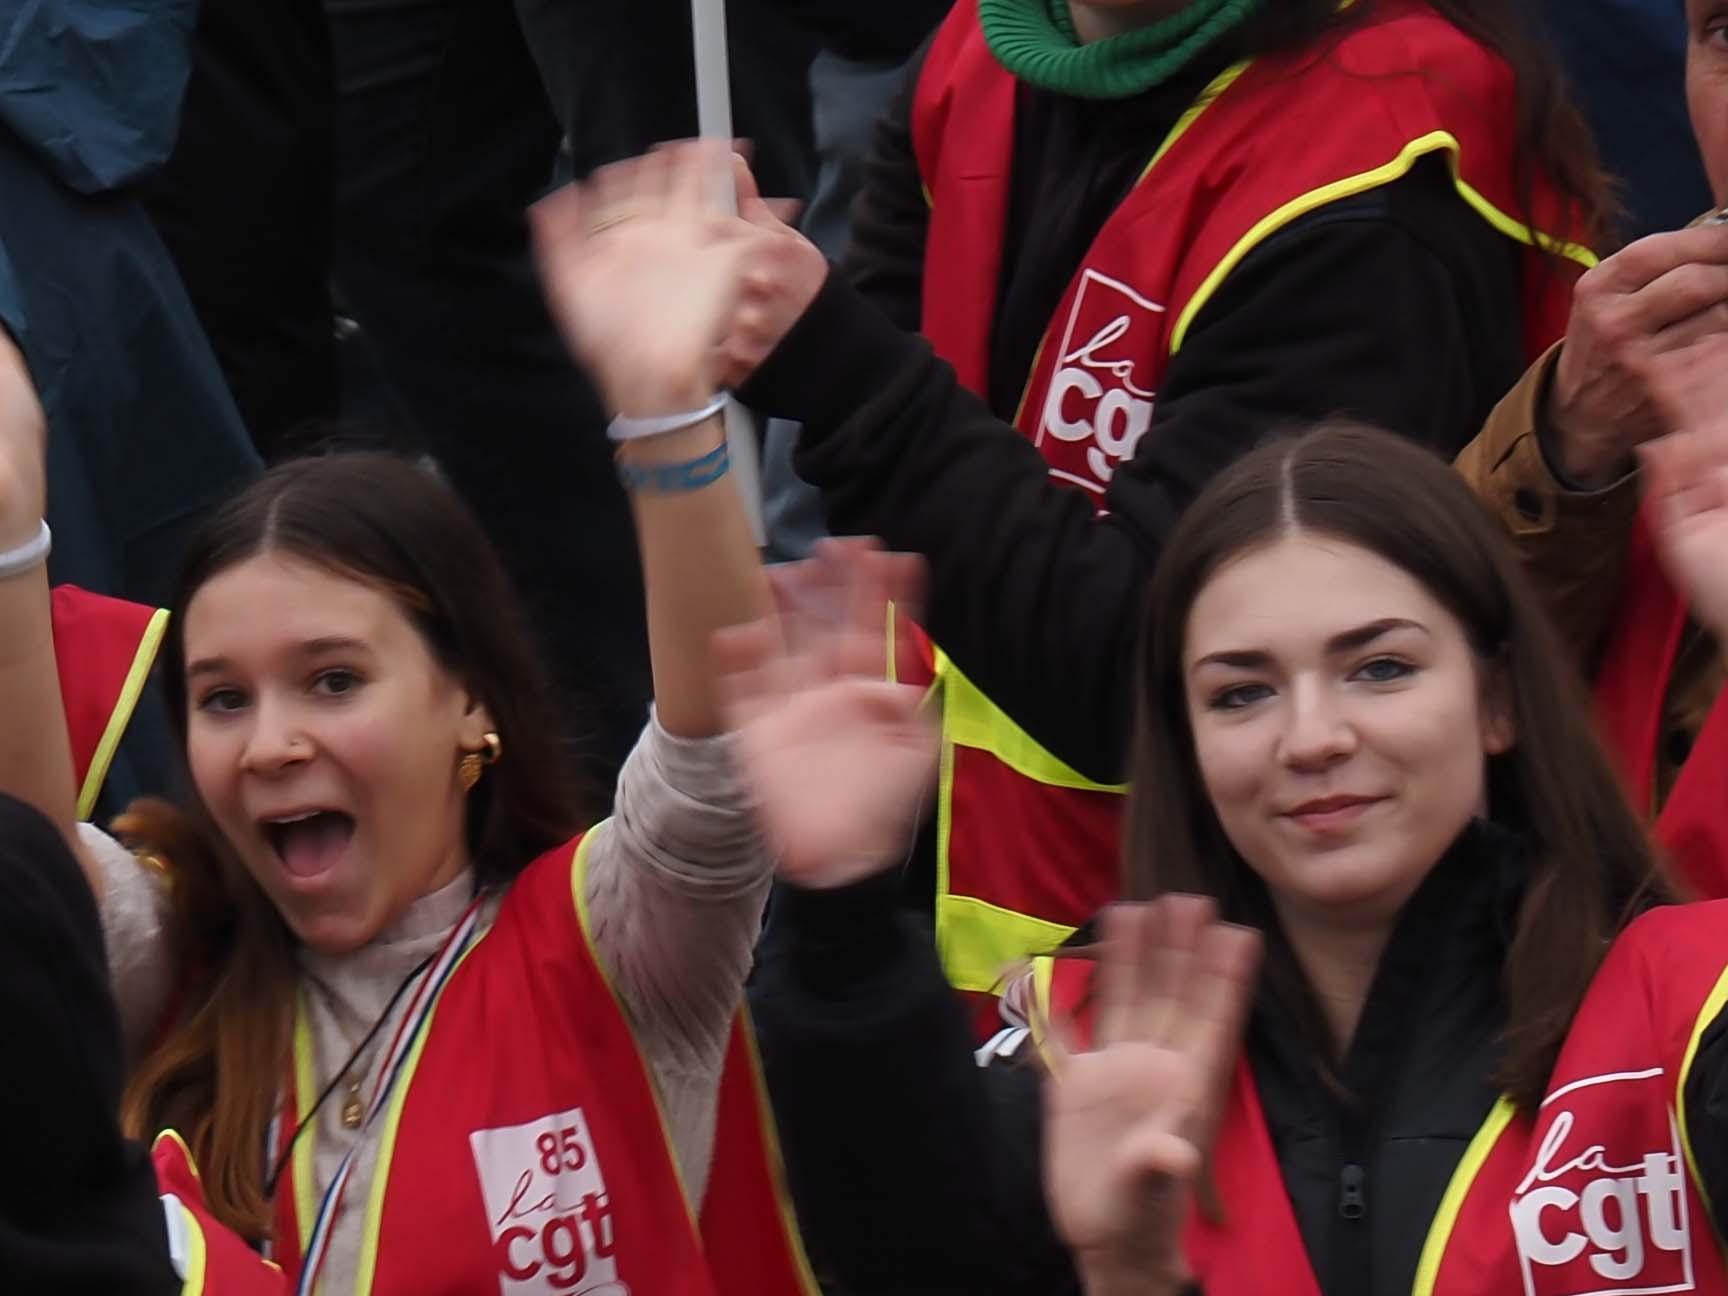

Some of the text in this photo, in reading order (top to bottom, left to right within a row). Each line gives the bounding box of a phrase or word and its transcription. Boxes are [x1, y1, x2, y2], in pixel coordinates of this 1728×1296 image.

[1044, 367, 1155, 482] cg
[536, 1126, 587, 1176] 85
[1515, 1110, 1646, 1195] la
[493, 1190, 616, 1289] cgt
[1518, 1151, 1686, 1281] cgt
